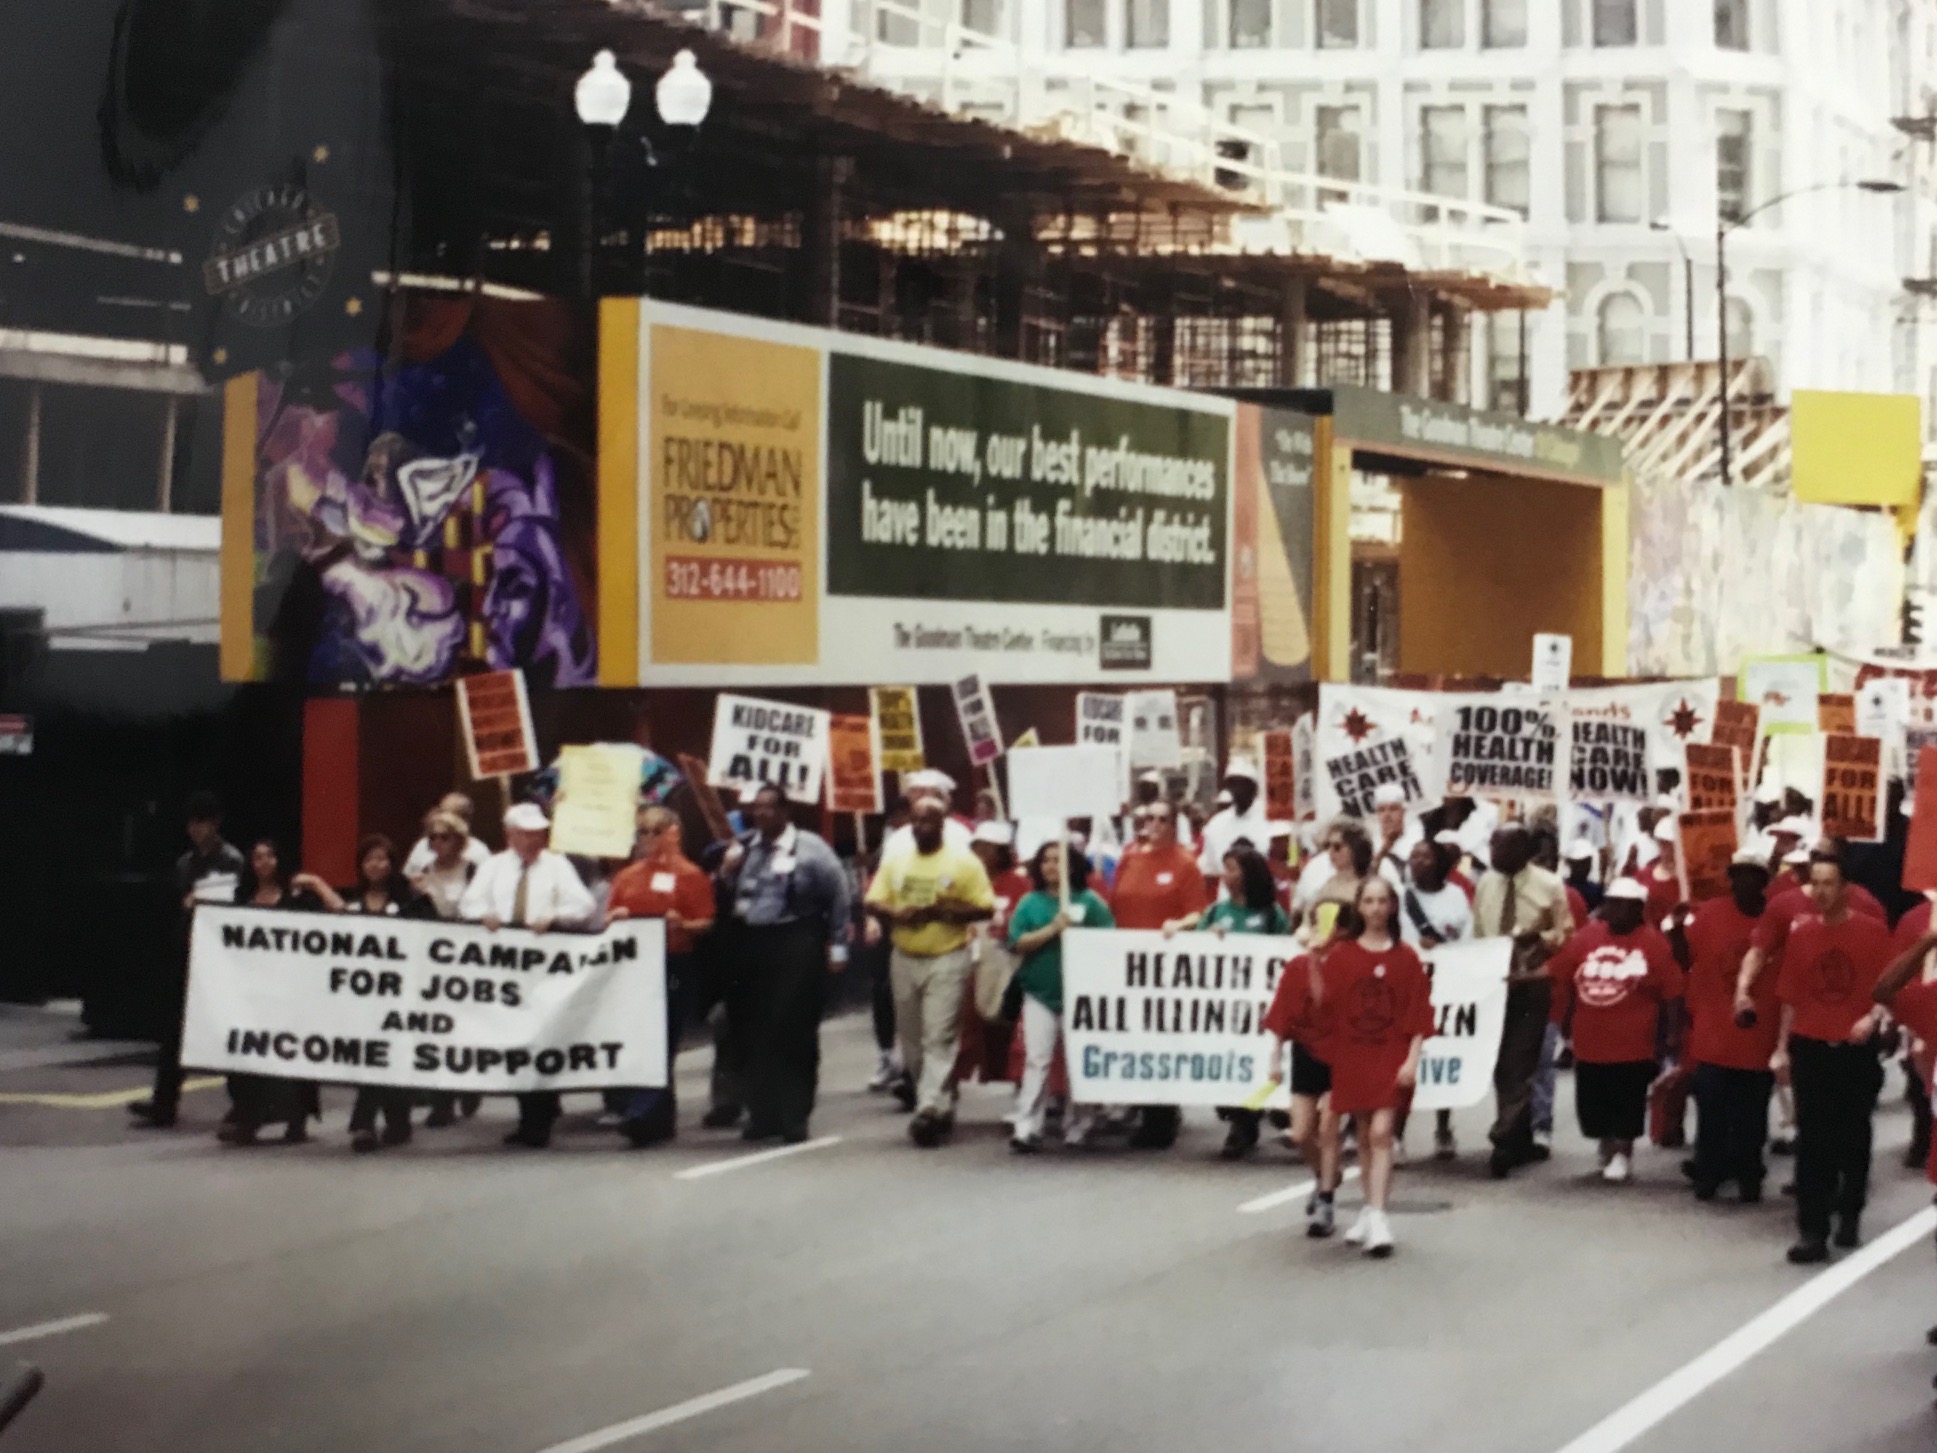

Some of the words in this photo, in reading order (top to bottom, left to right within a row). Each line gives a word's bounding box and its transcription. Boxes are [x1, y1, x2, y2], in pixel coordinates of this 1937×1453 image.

[216, 223, 325, 283] THEATRE
[664, 436, 801, 497] FRIEDMAN
[864, 401, 922, 468] Until
[929, 426, 981, 487] now,
[987, 434, 1026, 479] our
[1031, 424, 1079, 484] best
[1085, 435, 1214, 499] performances
[664, 494, 797, 549] PROPERTIES
[863, 480, 919, 546] have
[926, 488, 980, 548] been
[987, 494, 1007, 550] in
[1014, 499, 1049, 554] the
[1055, 499, 1143, 560] financial
[1147, 507, 1215, 563] district.
[668, 561, 801, 598] 312-644-1100
[731, 703, 815, 738] KIDCARE
[1083, 725, 1120, 743] FOR
[1456, 706, 1556, 739] 100%
[747, 735, 800, 757] FOR
[1327, 737, 1407, 780] HEALTH
[1452, 734, 1554, 764] HEALTH
[726, 754, 809, 791] ALL!
[1335, 760, 1411, 798] CARE
[1450, 762, 1553, 790] COVERAGE!
[1570, 767, 1648, 797] NOW!
[1826, 767, 1877, 789] FOR
[222, 924, 406, 960] NATIONAL
[330, 968, 401, 997] FOR
[421, 975, 521, 1007] JOBS
[1126, 952, 1252, 989] HEALTH
[381, 1011, 453, 1034] AND
[1072, 995, 1128, 1033] ALL
[228, 1029, 389, 1067] INCOME
[414, 1042, 623, 1075] SUPPORT
[1083, 1044, 1253, 1082] Grassroots
